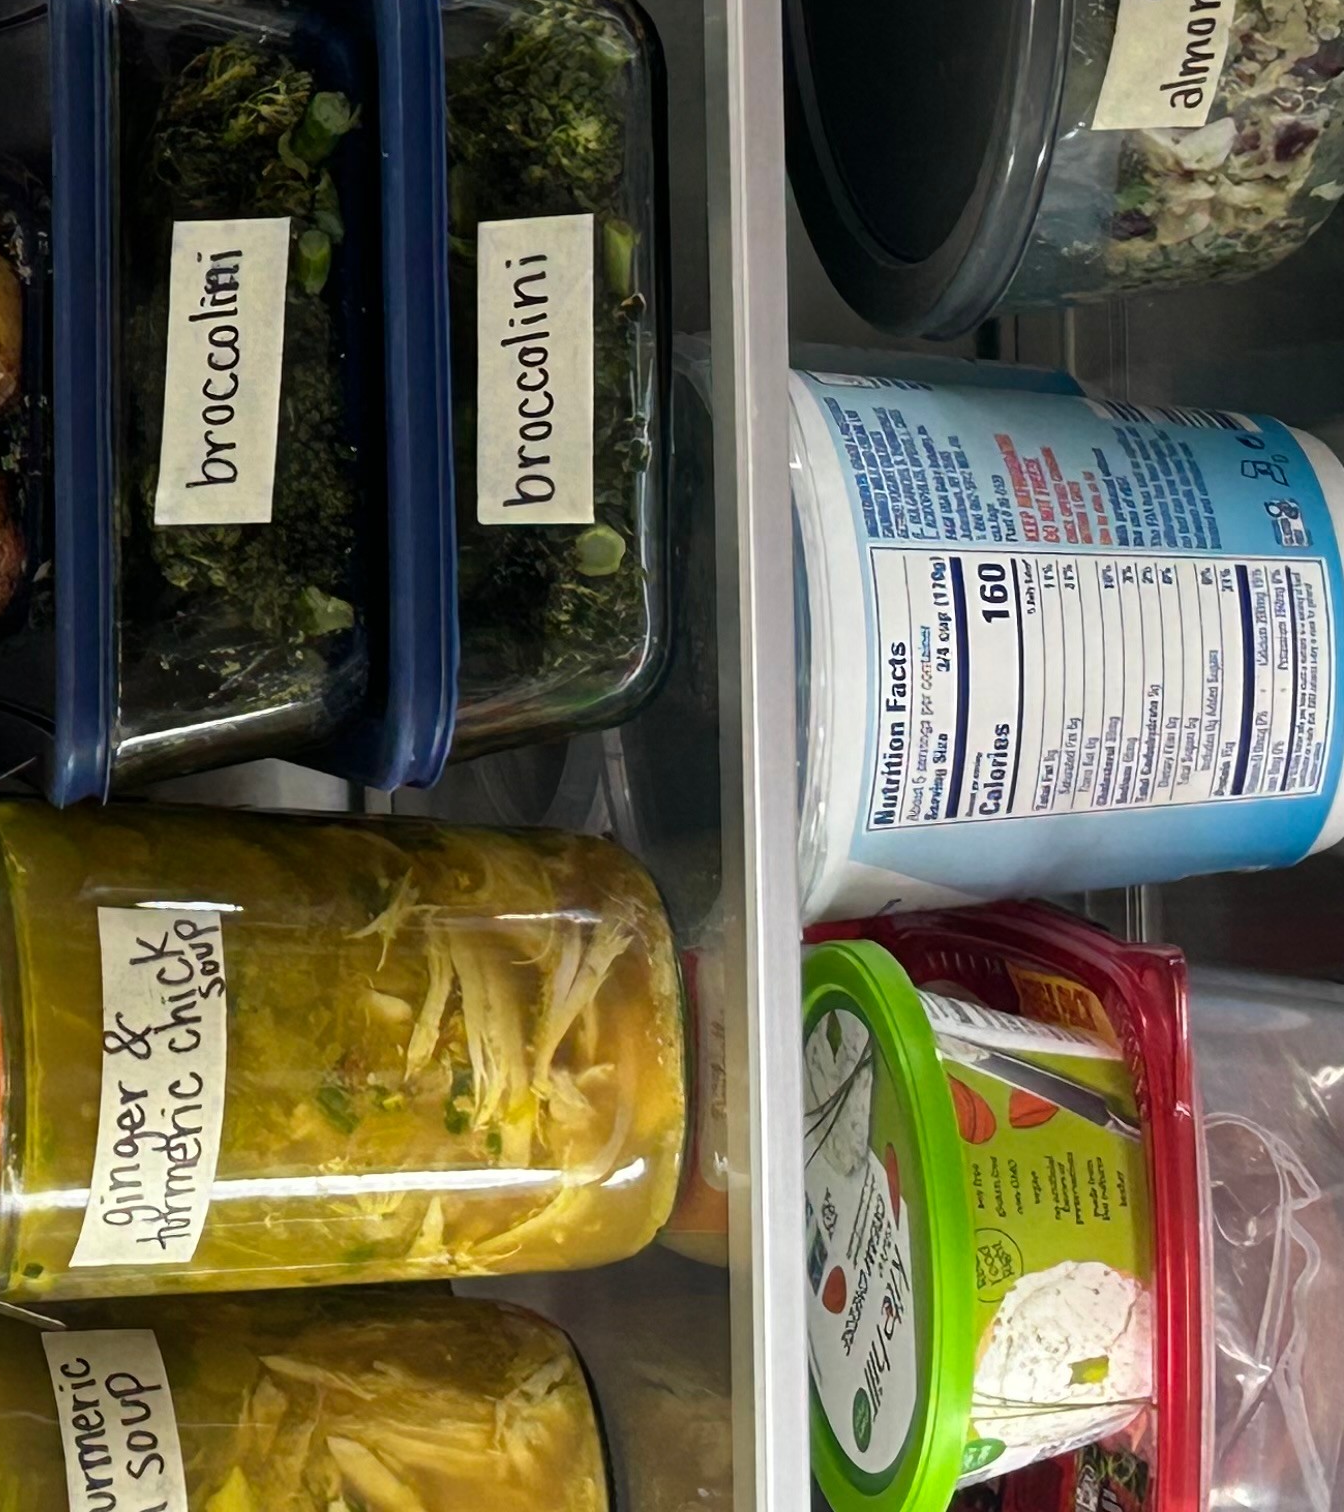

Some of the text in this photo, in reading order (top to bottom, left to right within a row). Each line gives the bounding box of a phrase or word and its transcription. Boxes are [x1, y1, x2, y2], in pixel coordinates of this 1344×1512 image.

[184, 248, 243, 489] broccolini
[500, 252, 555, 507] broccolini
[873, 641, 907, 825] Nutrition Facts
[976, 563, 1011, 815] Calories 160
[173, 918, 224, 998] soup
[100, 1011, 170, 1226] ginger &
[129, 931, 203, 1249] turmeric chick
[103, 1371, 161, 1479] soup
